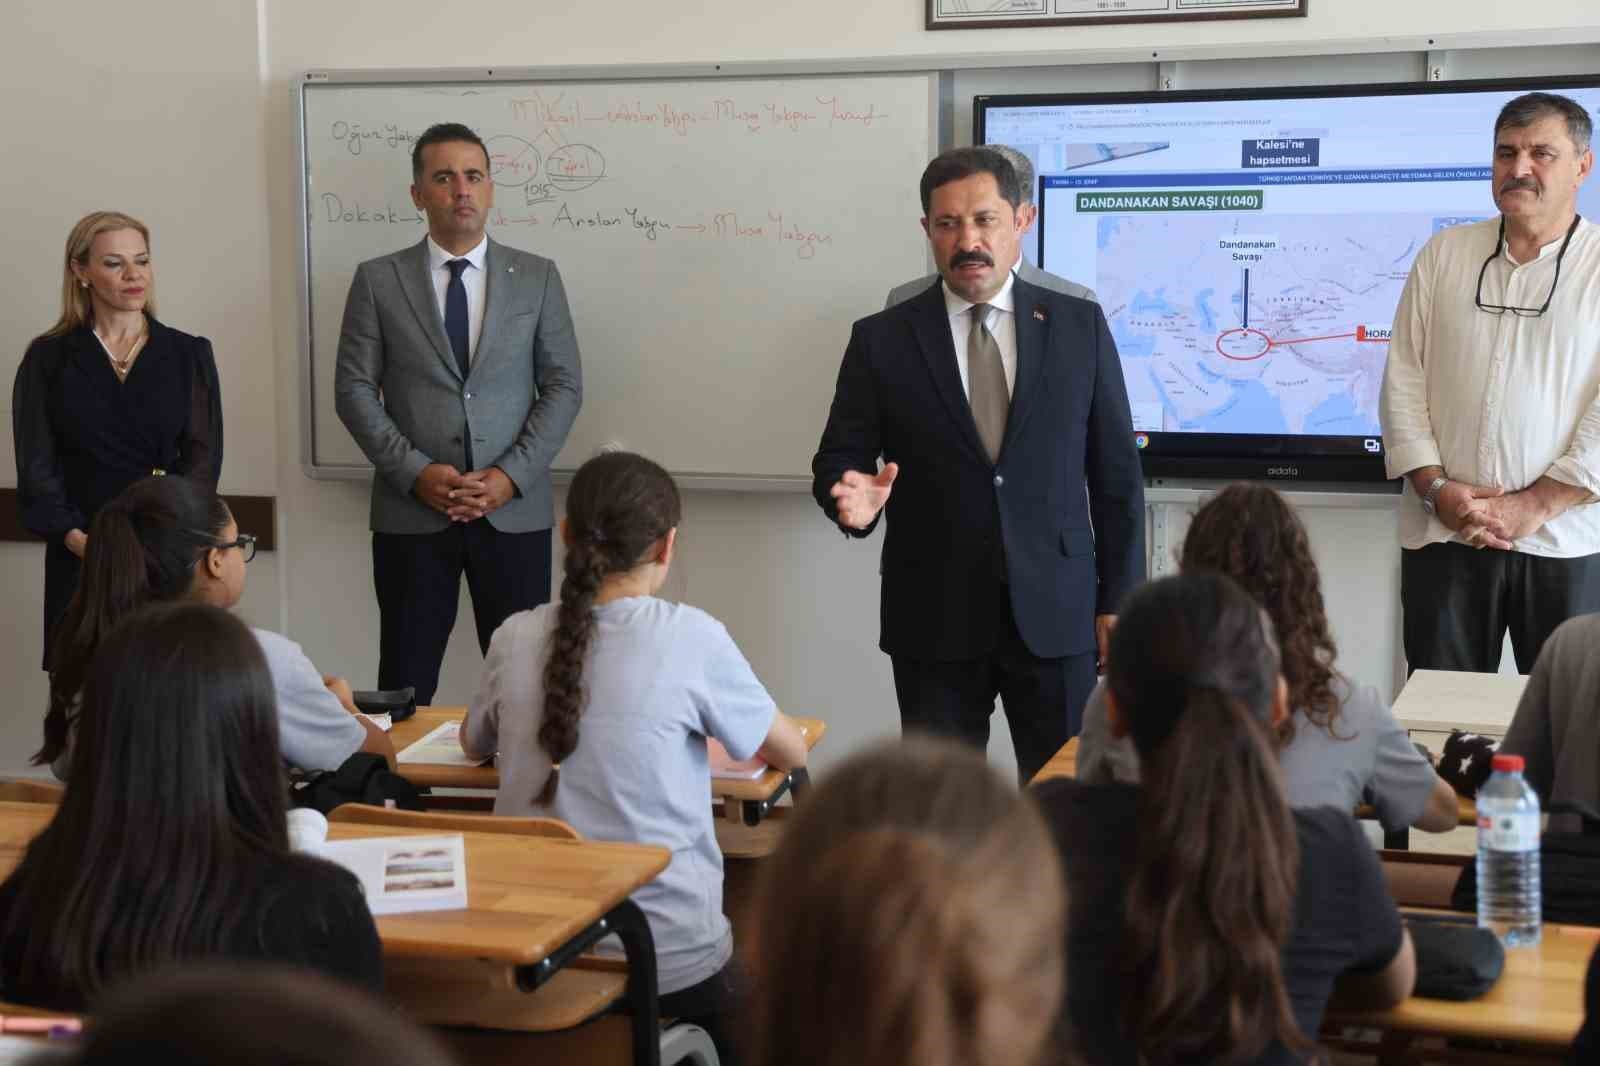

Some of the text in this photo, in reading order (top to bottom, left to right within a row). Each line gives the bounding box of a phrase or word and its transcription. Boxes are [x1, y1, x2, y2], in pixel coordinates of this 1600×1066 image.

[1256, 138, 1305, 150] Kalesi'ne
[1249, 154, 1311, 168] hapsetmesi
[321, 192, 402, 224] Dokak
[1080, 193, 1258, 211] DANDANAKAN SAVAŞI (1040)
[1219, 239, 1276, 249] Dandanakan
[1232, 252, 1262, 263] Savaşı
